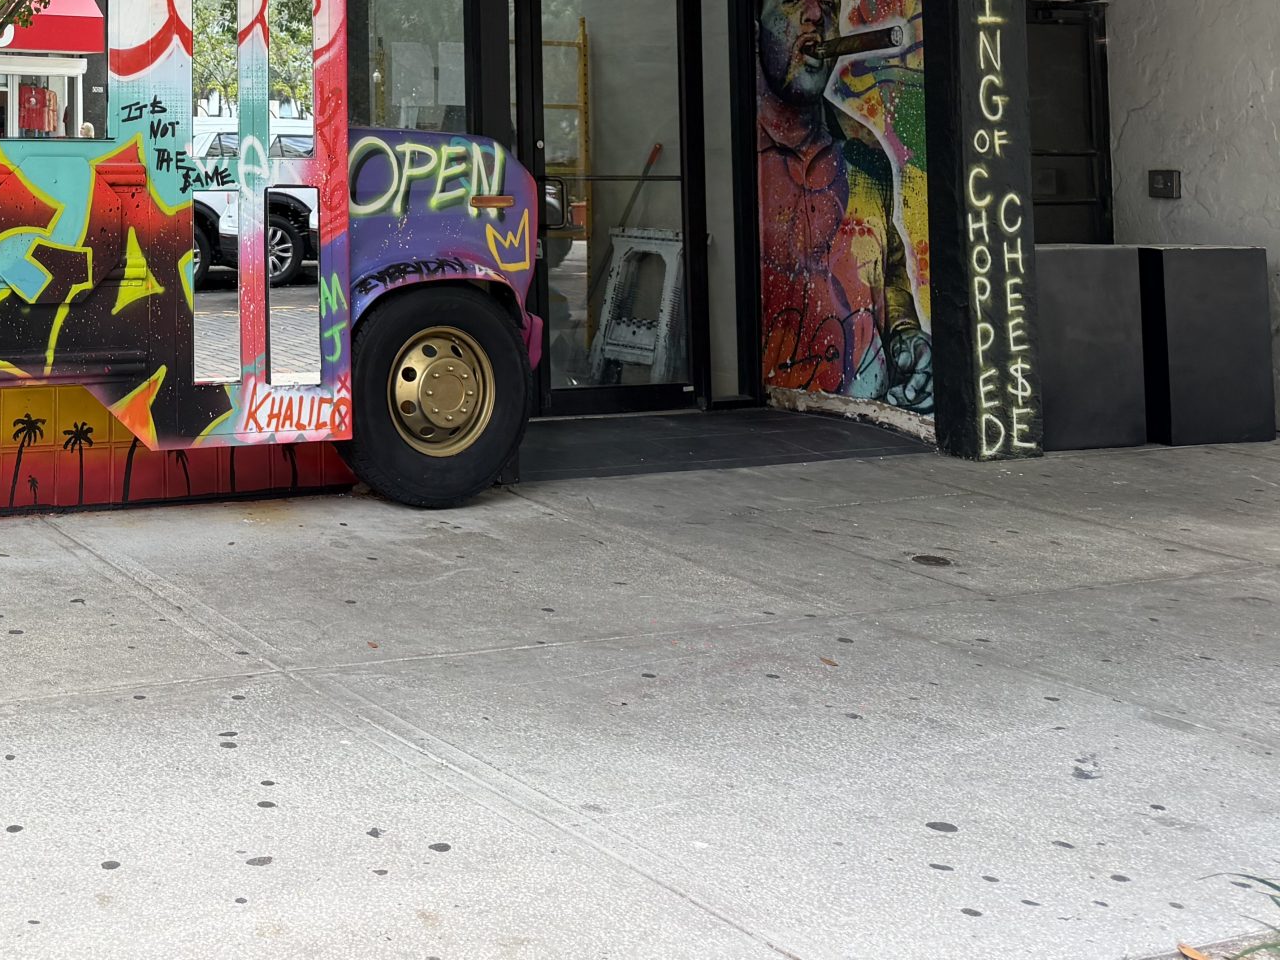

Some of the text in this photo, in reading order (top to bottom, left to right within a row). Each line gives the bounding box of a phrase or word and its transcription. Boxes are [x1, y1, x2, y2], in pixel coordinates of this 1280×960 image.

[149, 119, 180, 145] NOT
[974, 129, 1009, 158] OF
[153, 147, 188, 173] THE
[349, 135, 505, 219] OPEN
[968, 167, 1007, 456] CHOPPED
